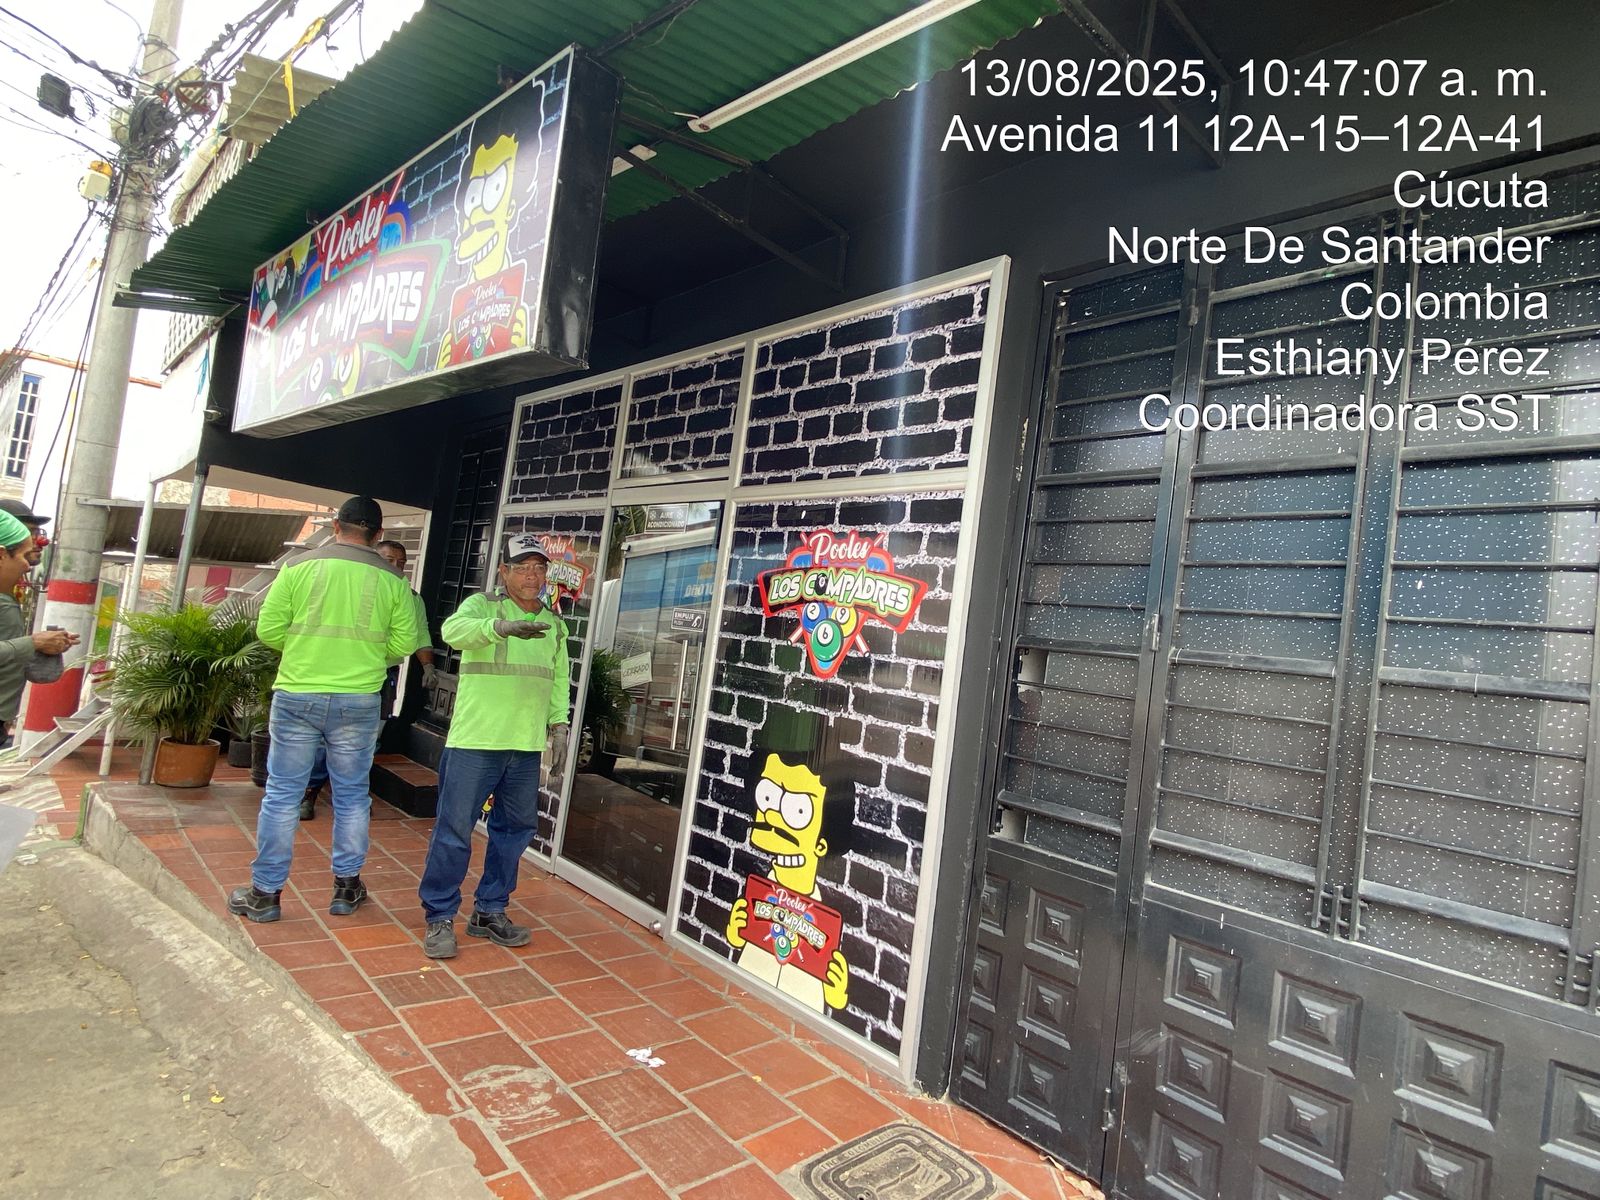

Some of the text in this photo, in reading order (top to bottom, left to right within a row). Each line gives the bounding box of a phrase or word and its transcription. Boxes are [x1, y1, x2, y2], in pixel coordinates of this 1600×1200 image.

[322, 194, 387, 281] Pooles
[278, 316, 308, 378] LOS
[809, 532, 872, 564] Pooles
[771, 567, 911, 612] LOS COMPADRES
[755, 902, 772, 918] LOS
[776, 888, 807, 913] Pooles
